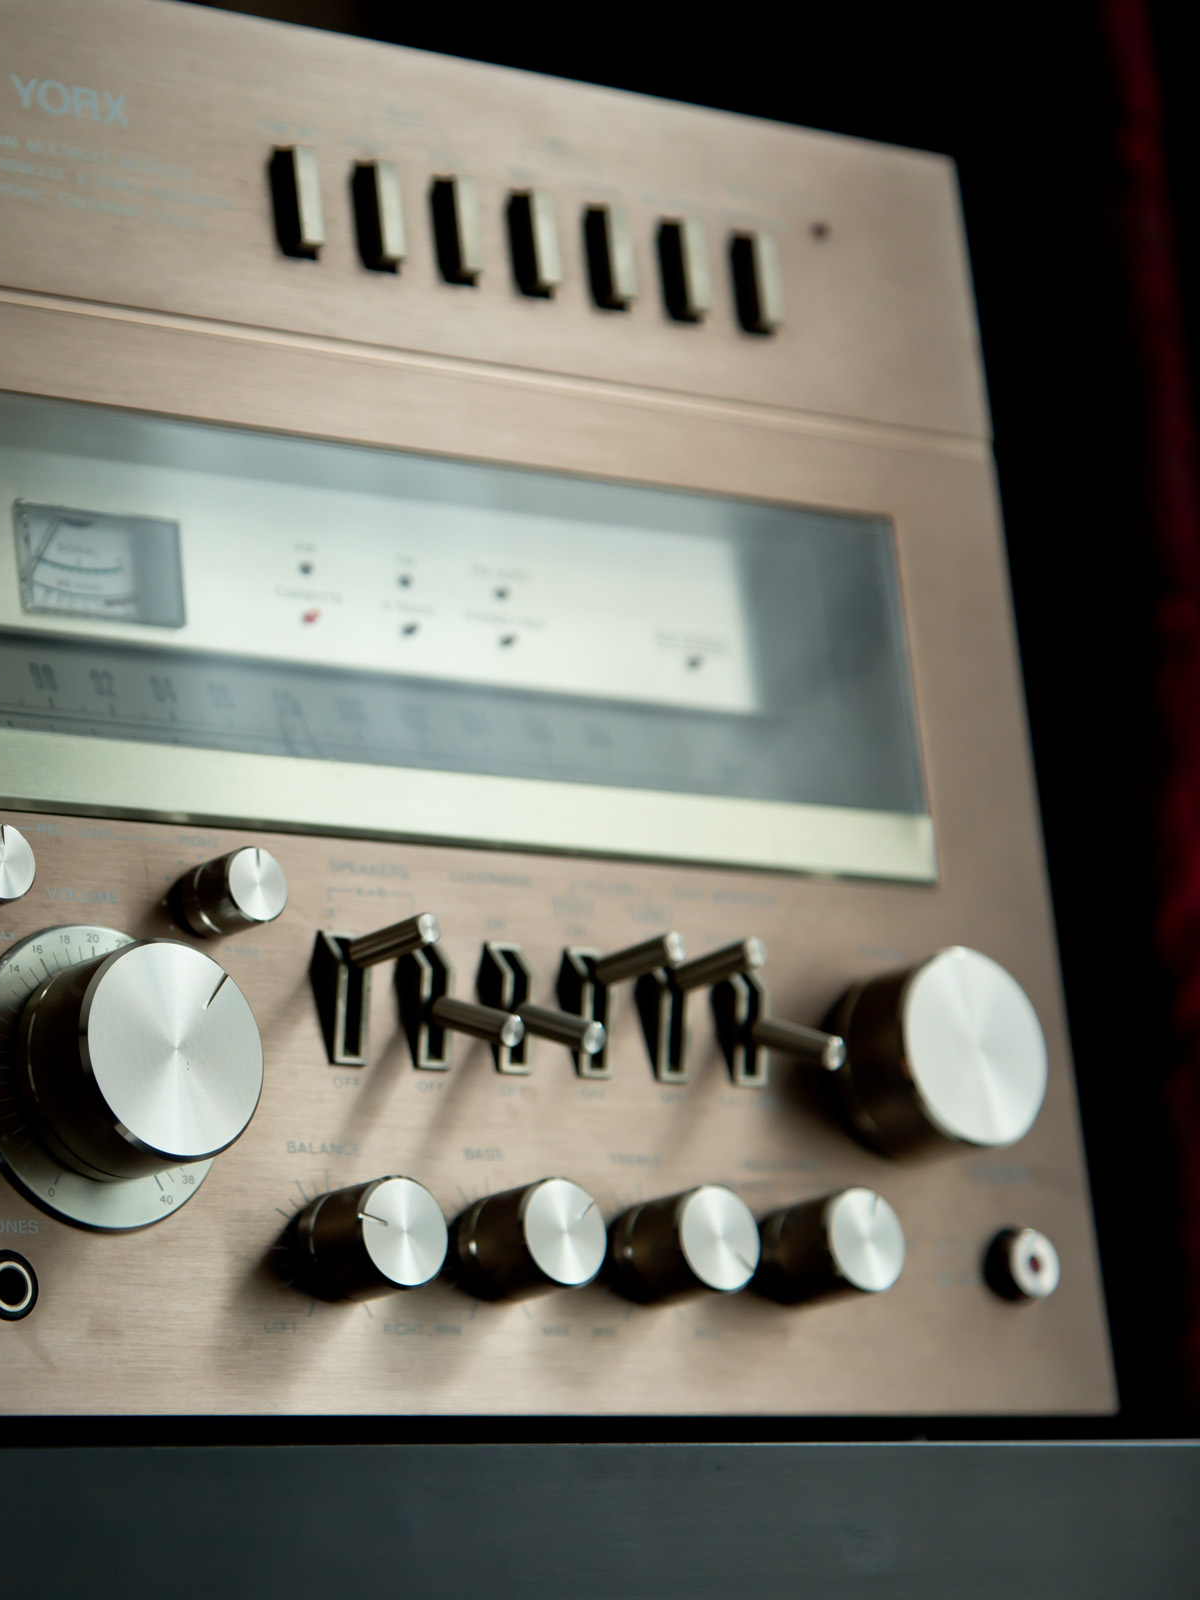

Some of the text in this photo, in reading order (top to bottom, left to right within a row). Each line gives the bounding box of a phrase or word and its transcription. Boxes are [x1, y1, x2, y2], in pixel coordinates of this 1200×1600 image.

[10, 73, 130, 127] YORX
[46, 887, 119, 906] VOLUME
[59, 934, 71, 945] 18
[86, 933, 100, 944] 20
[32, 944, 43, 955] 16
[9, 964, 20, 974] 14
[286, 1140, 362, 1157] BALANCE
[182, 1175, 195, 1186] 38
[48, 1188, 55, 1198] 0
[160, 1196, 173, 1206] 40
